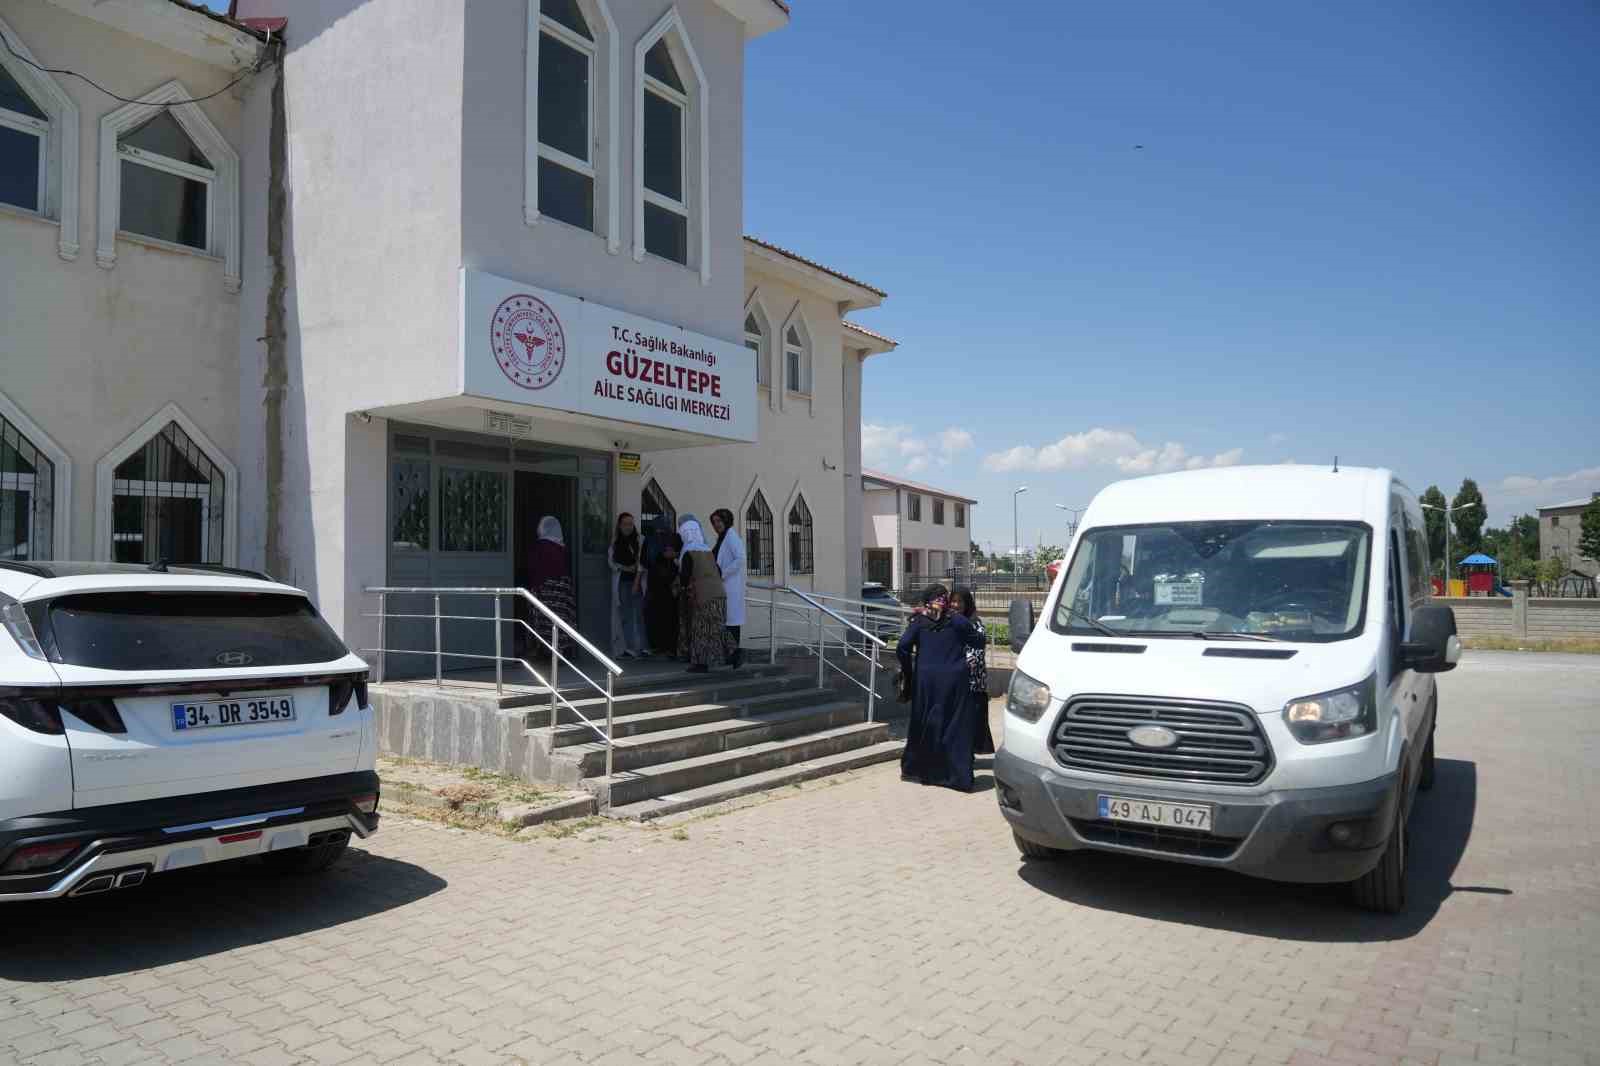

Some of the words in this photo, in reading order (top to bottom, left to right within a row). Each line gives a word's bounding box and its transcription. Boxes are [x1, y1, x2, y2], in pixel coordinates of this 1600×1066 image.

[611, 326, 633, 344] T.C.
[635, 332, 668, 352] Sağlık
[670, 341, 717, 367] Bakanlığı
[606, 347, 721, 398] GÜZELTEPE
[594, 379, 625, 400] AİLE
[681, 397, 730, 421] MERKEZİ
[186, 706, 210, 726] 34
[219, 703, 241, 723] DR
[248, 699, 290, 721] 3549
[1110, 801, 1130, 818] 49
[1141, 804, 1162, 822] AJ
[1174, 807, 1207, 827] 047
